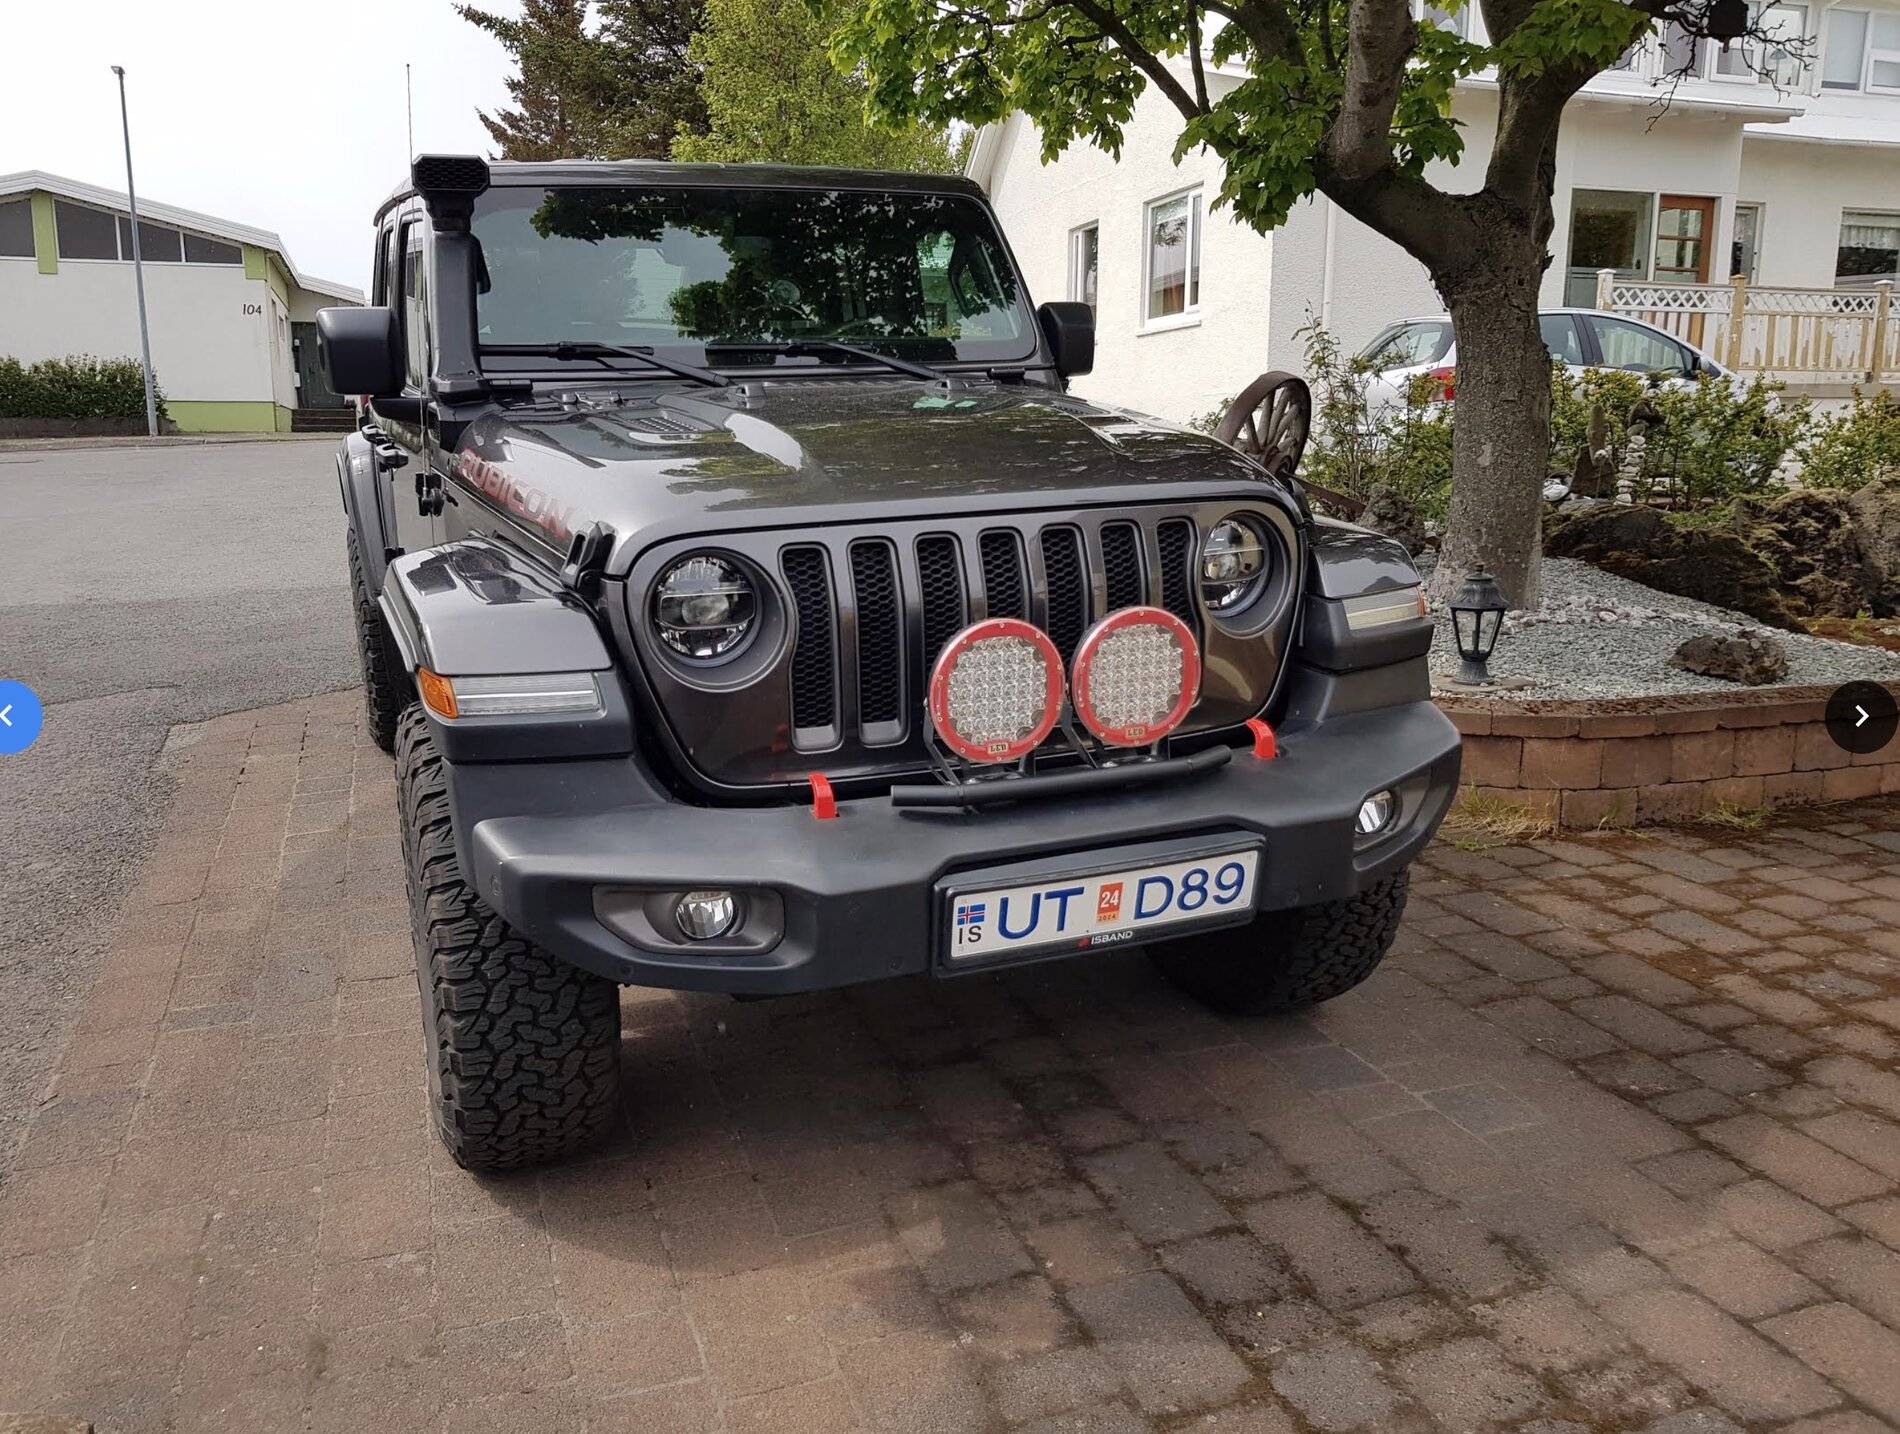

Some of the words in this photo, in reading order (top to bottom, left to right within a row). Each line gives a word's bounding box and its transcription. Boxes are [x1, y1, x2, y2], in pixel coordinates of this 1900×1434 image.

[242, 304, 262, 315] 104
[457, 448, 574, 541] RUBICON
[997, 886, 1085, 940] UT
[1133, 862, 1246, 920] D89
[1100, 889, 1120, 908] 24
[958, 925, 982, 945] IS
[1091, 930, 1133, 945] ISBAND
